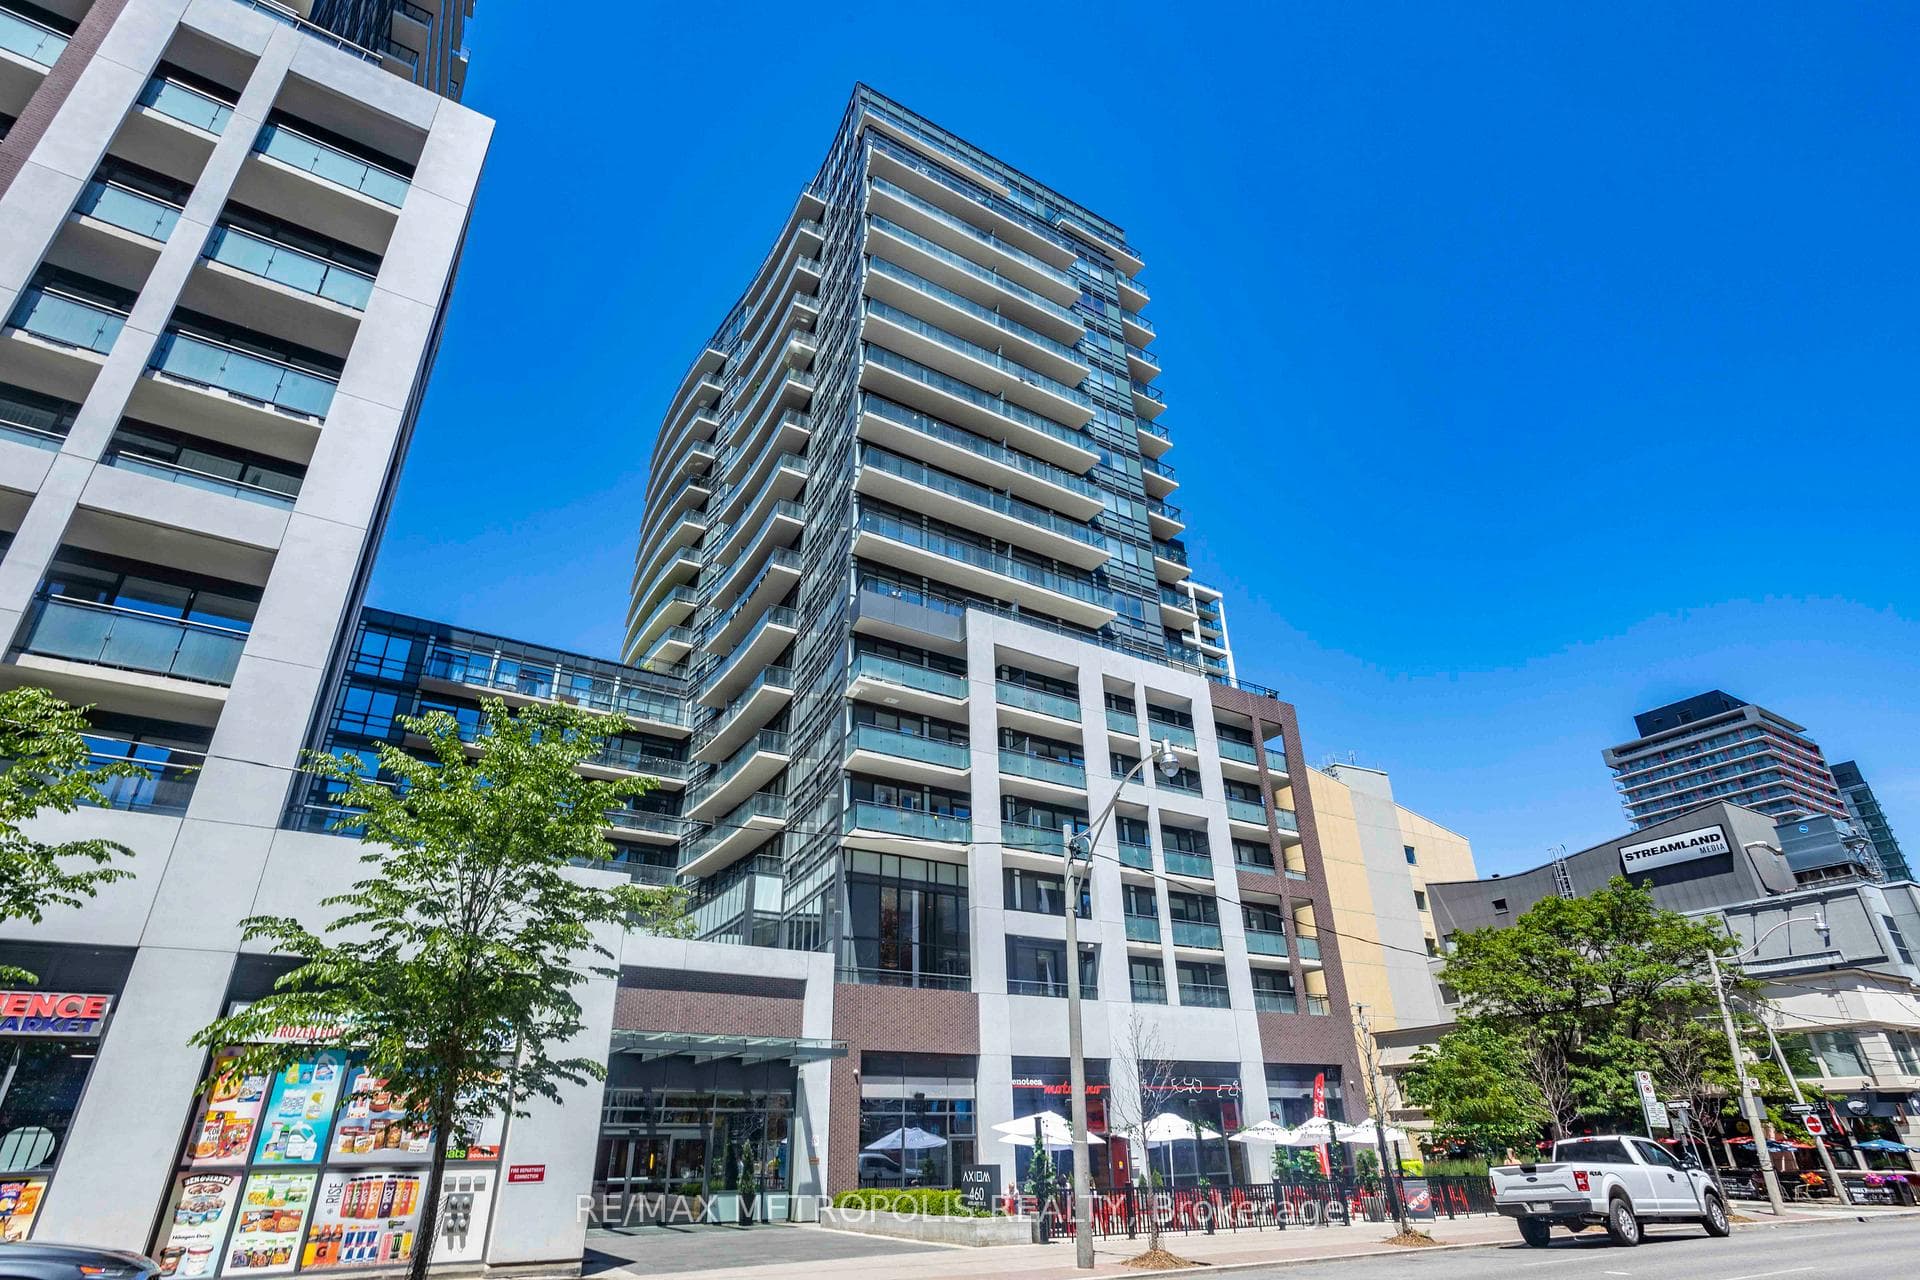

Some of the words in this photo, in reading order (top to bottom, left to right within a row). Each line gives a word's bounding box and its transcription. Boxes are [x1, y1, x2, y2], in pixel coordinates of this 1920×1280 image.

[1624, 833, 1721, 862] STREAMLAND
[1699, 842, 1726, 855] MEDIA
[273, 1025, 316, 1039] FROZEN
[970, 1187, 985, 1201] 460
